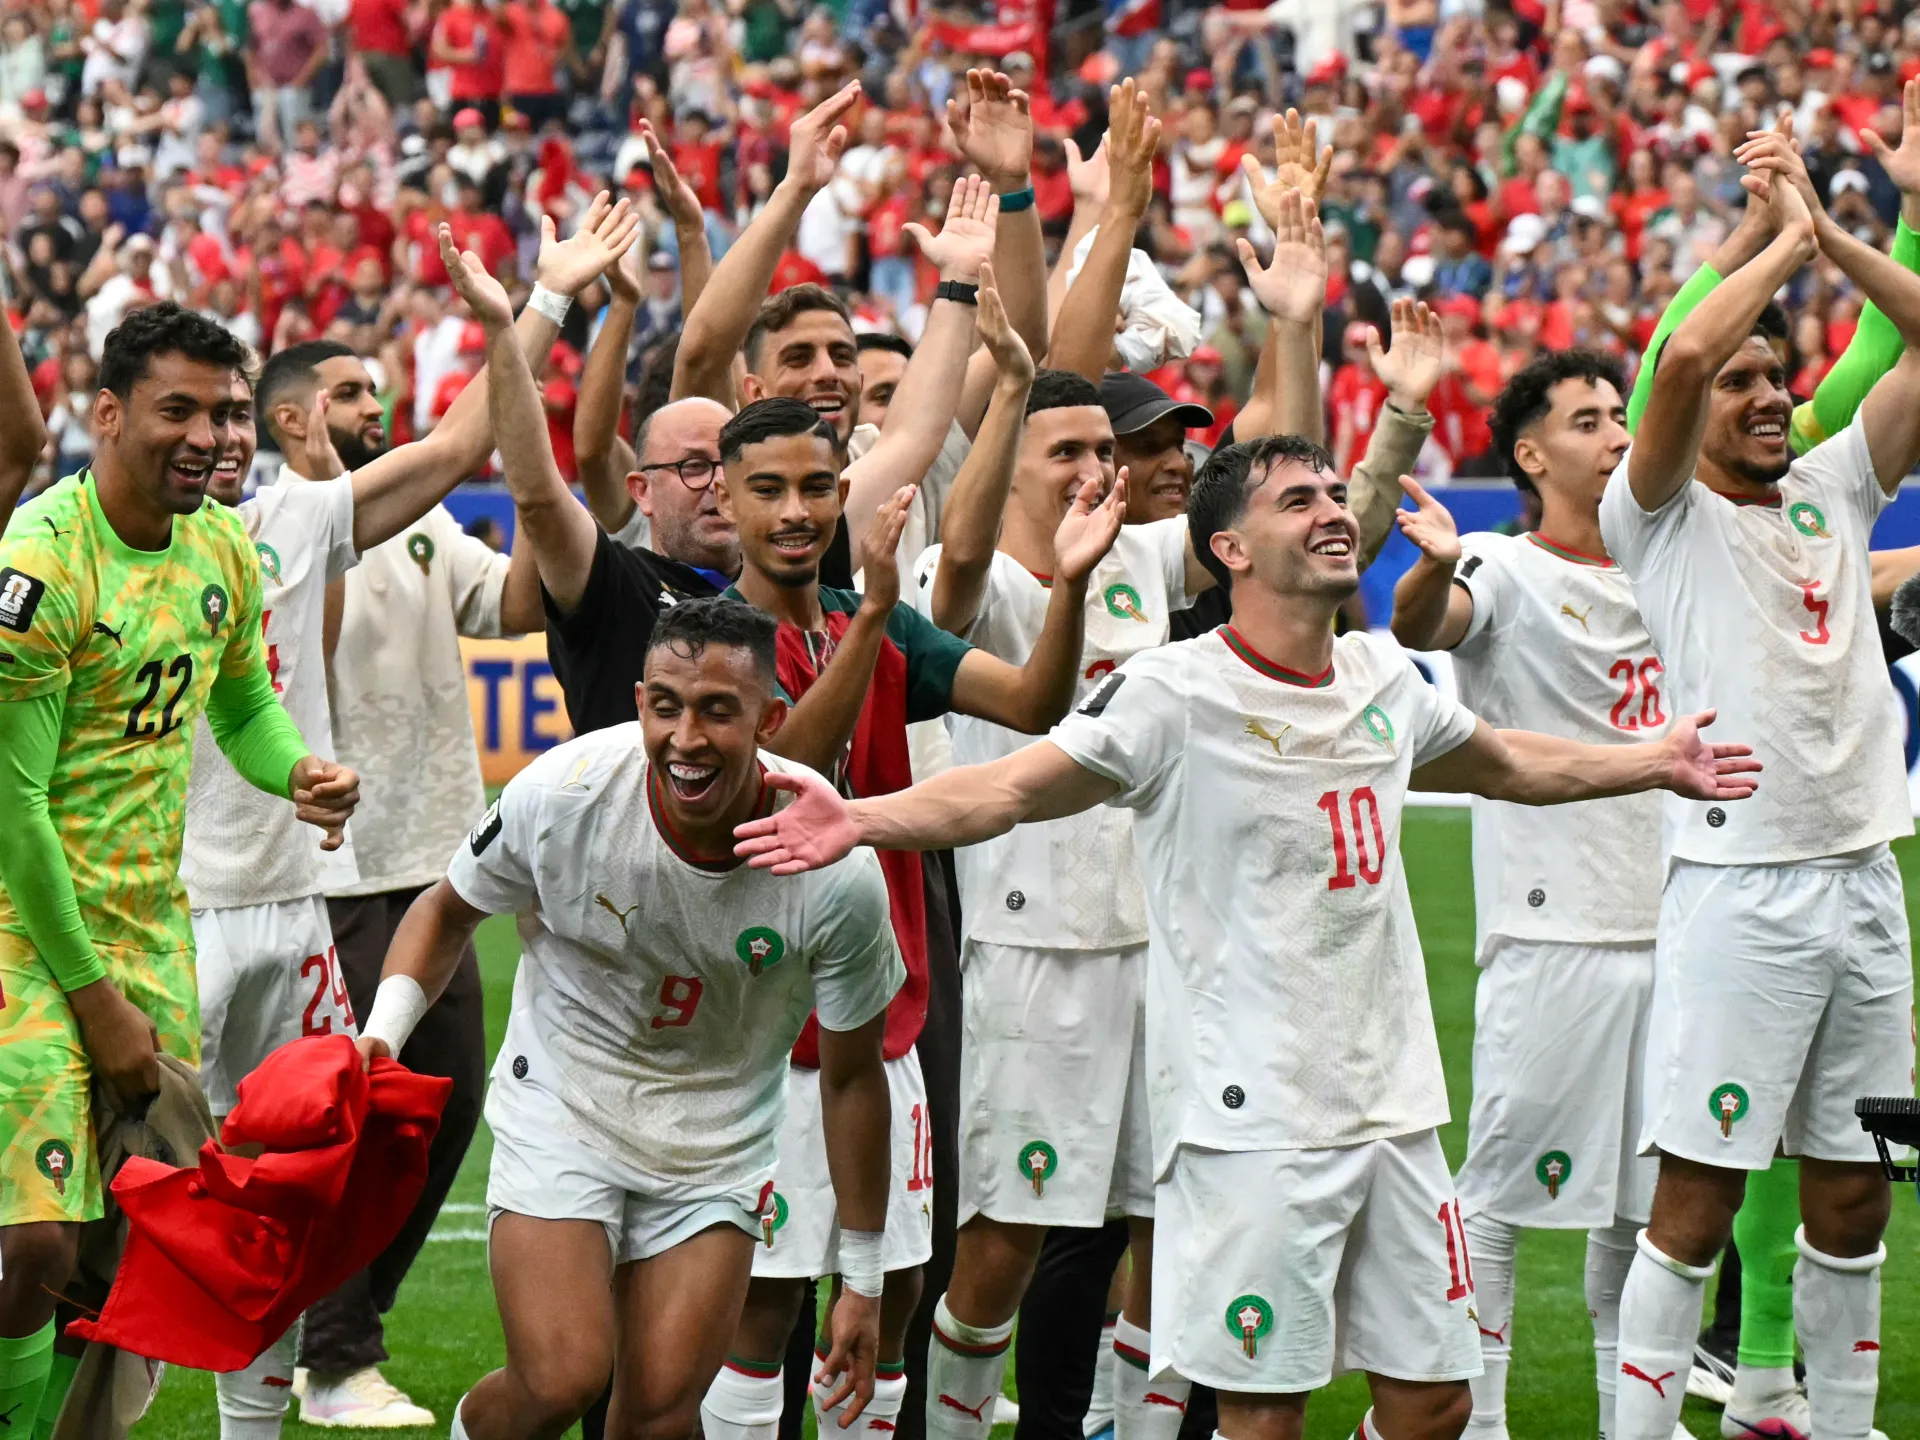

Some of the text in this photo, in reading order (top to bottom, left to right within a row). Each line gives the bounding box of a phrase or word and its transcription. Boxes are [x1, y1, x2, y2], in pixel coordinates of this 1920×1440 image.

[1799, 580, 1831, 645] 5
[123, 653, 193, 738] 22
[1608, 656, 1667, 731] 26
[1316, 785, 1386, 891] 10
[300, 944, 356, 1037] 24
[651, 975, 704, 1030] 9
